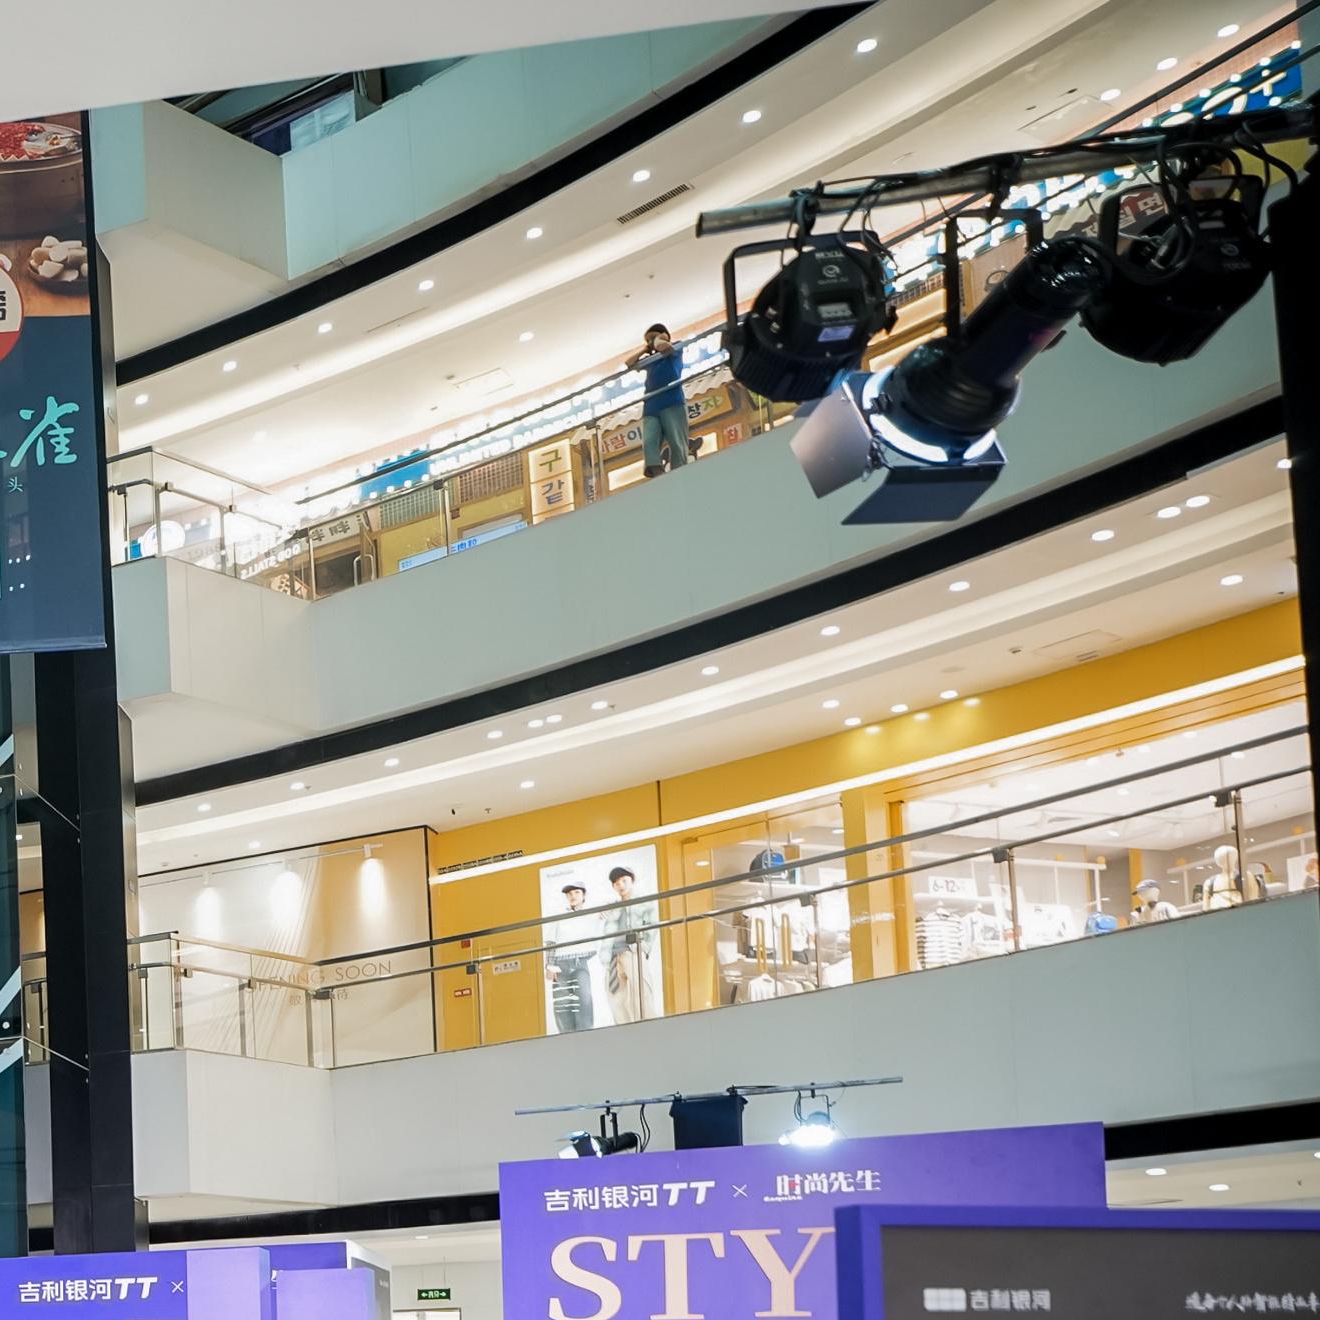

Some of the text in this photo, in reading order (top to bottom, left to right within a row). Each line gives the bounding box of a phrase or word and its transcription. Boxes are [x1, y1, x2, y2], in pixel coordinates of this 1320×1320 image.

[335, 960, 392, 982] SOON
[543, 1169, 882, 1212] 吉利银河TT 时尚先生
[18, 1276, 158, 1303] 吉利银河TT
[971, 1289, 1052, 1312] 吉利银河
